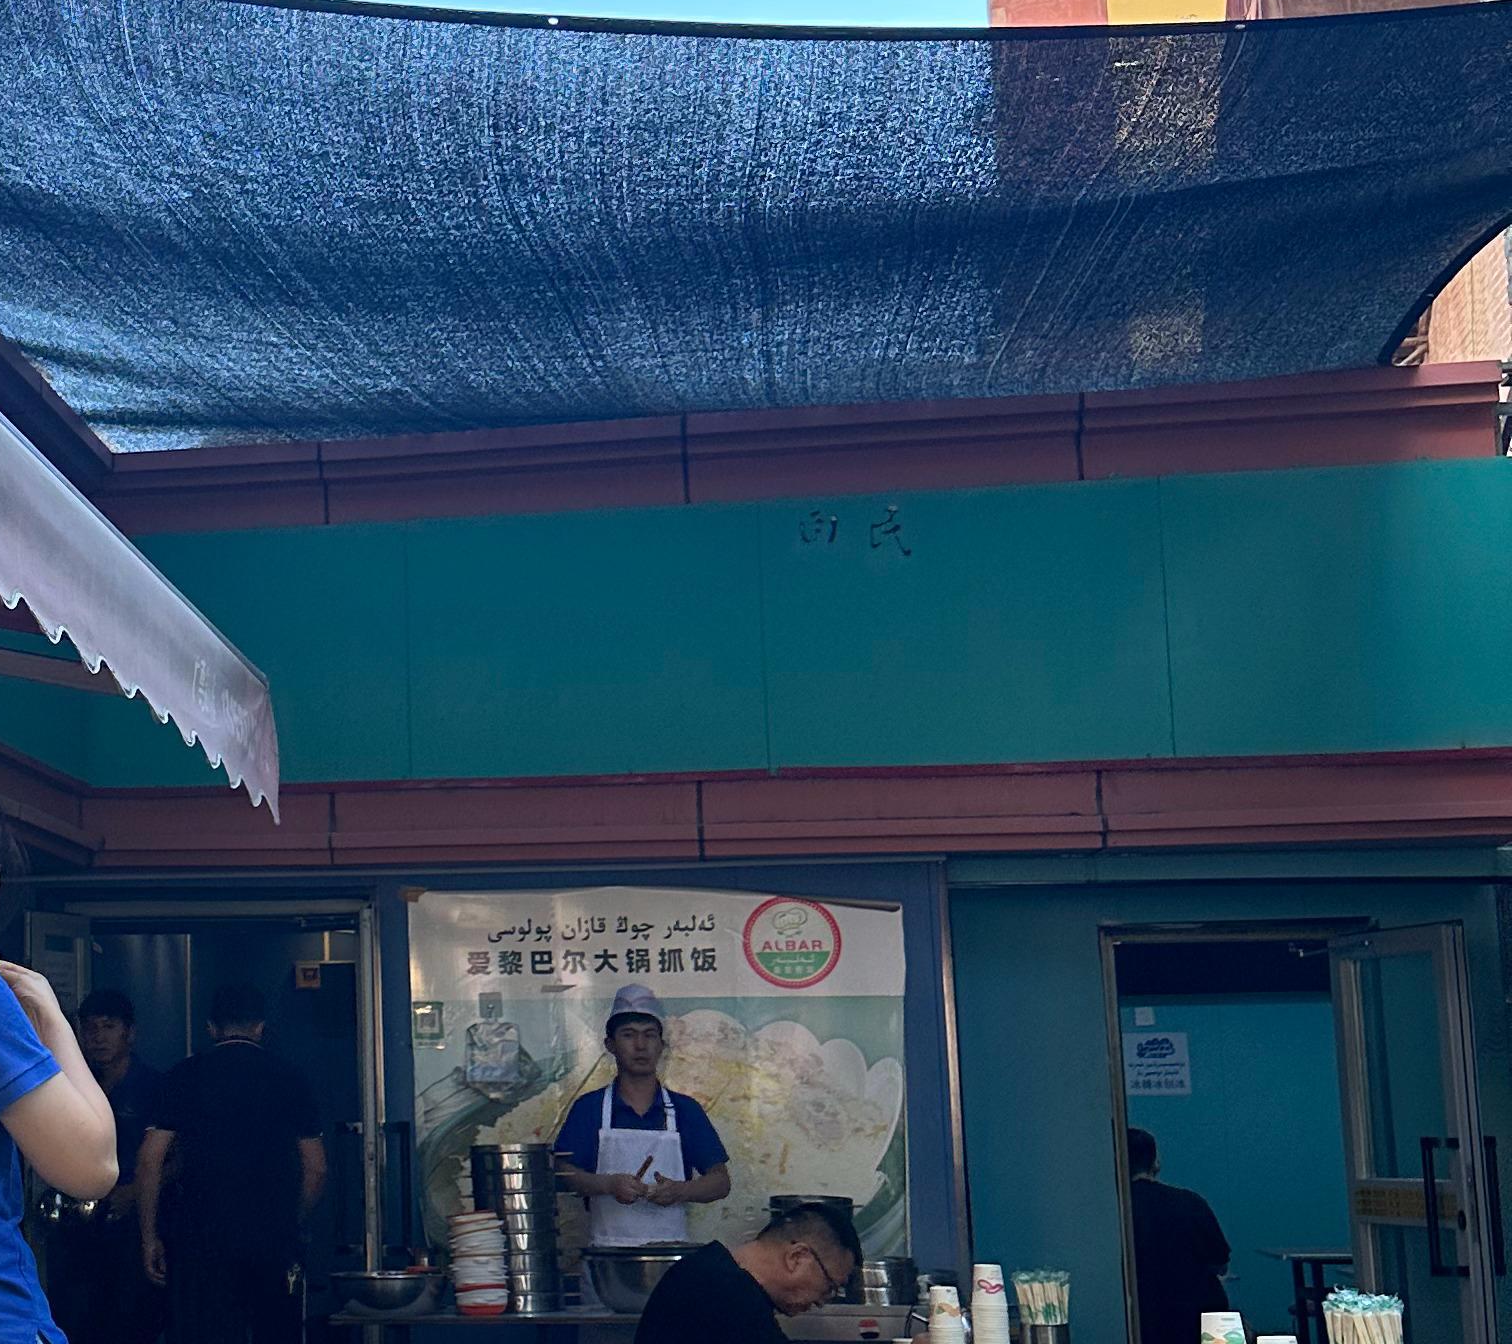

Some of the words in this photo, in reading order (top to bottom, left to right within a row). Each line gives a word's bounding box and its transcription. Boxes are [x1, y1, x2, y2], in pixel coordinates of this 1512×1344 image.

[561, 916, 606, 941] قازان
[616, 915, 655, 941] چوڭ
[761, 939, 823, 952] ALBAR
[467, 947, 717, 976] 爱黎巴尔大锅抓饭
